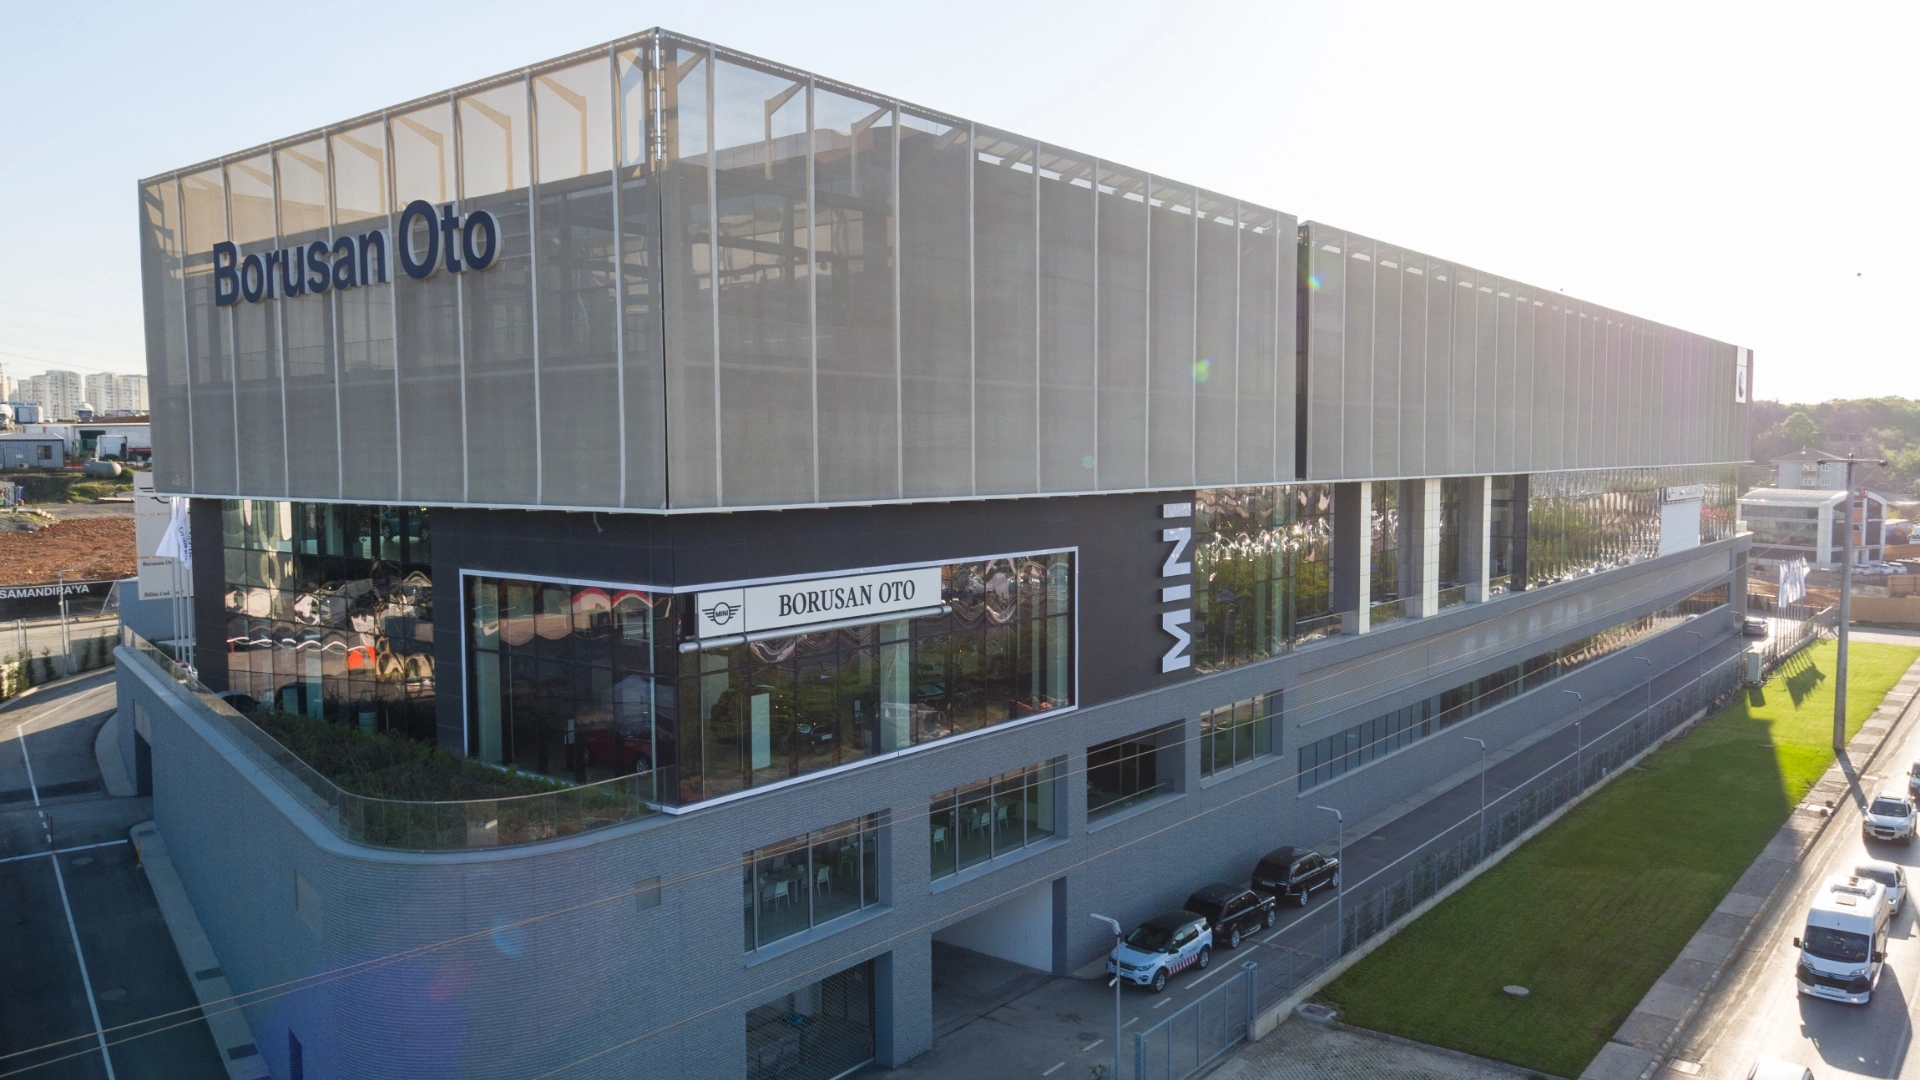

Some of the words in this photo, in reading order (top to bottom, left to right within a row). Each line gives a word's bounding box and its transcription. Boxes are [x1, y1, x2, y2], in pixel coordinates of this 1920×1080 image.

[213, 229, 390, 307] Borusan
[399, 199, 501, 280] Oto
[0, 585, 89, 599] SAMANDIRA'YA
[779, 584, 873, 617] BORUSAN
[878, 579, 916, 604] OTO
[1162, 502, 1192, 674] MINI
[715, 610, 729, 618] MINI
